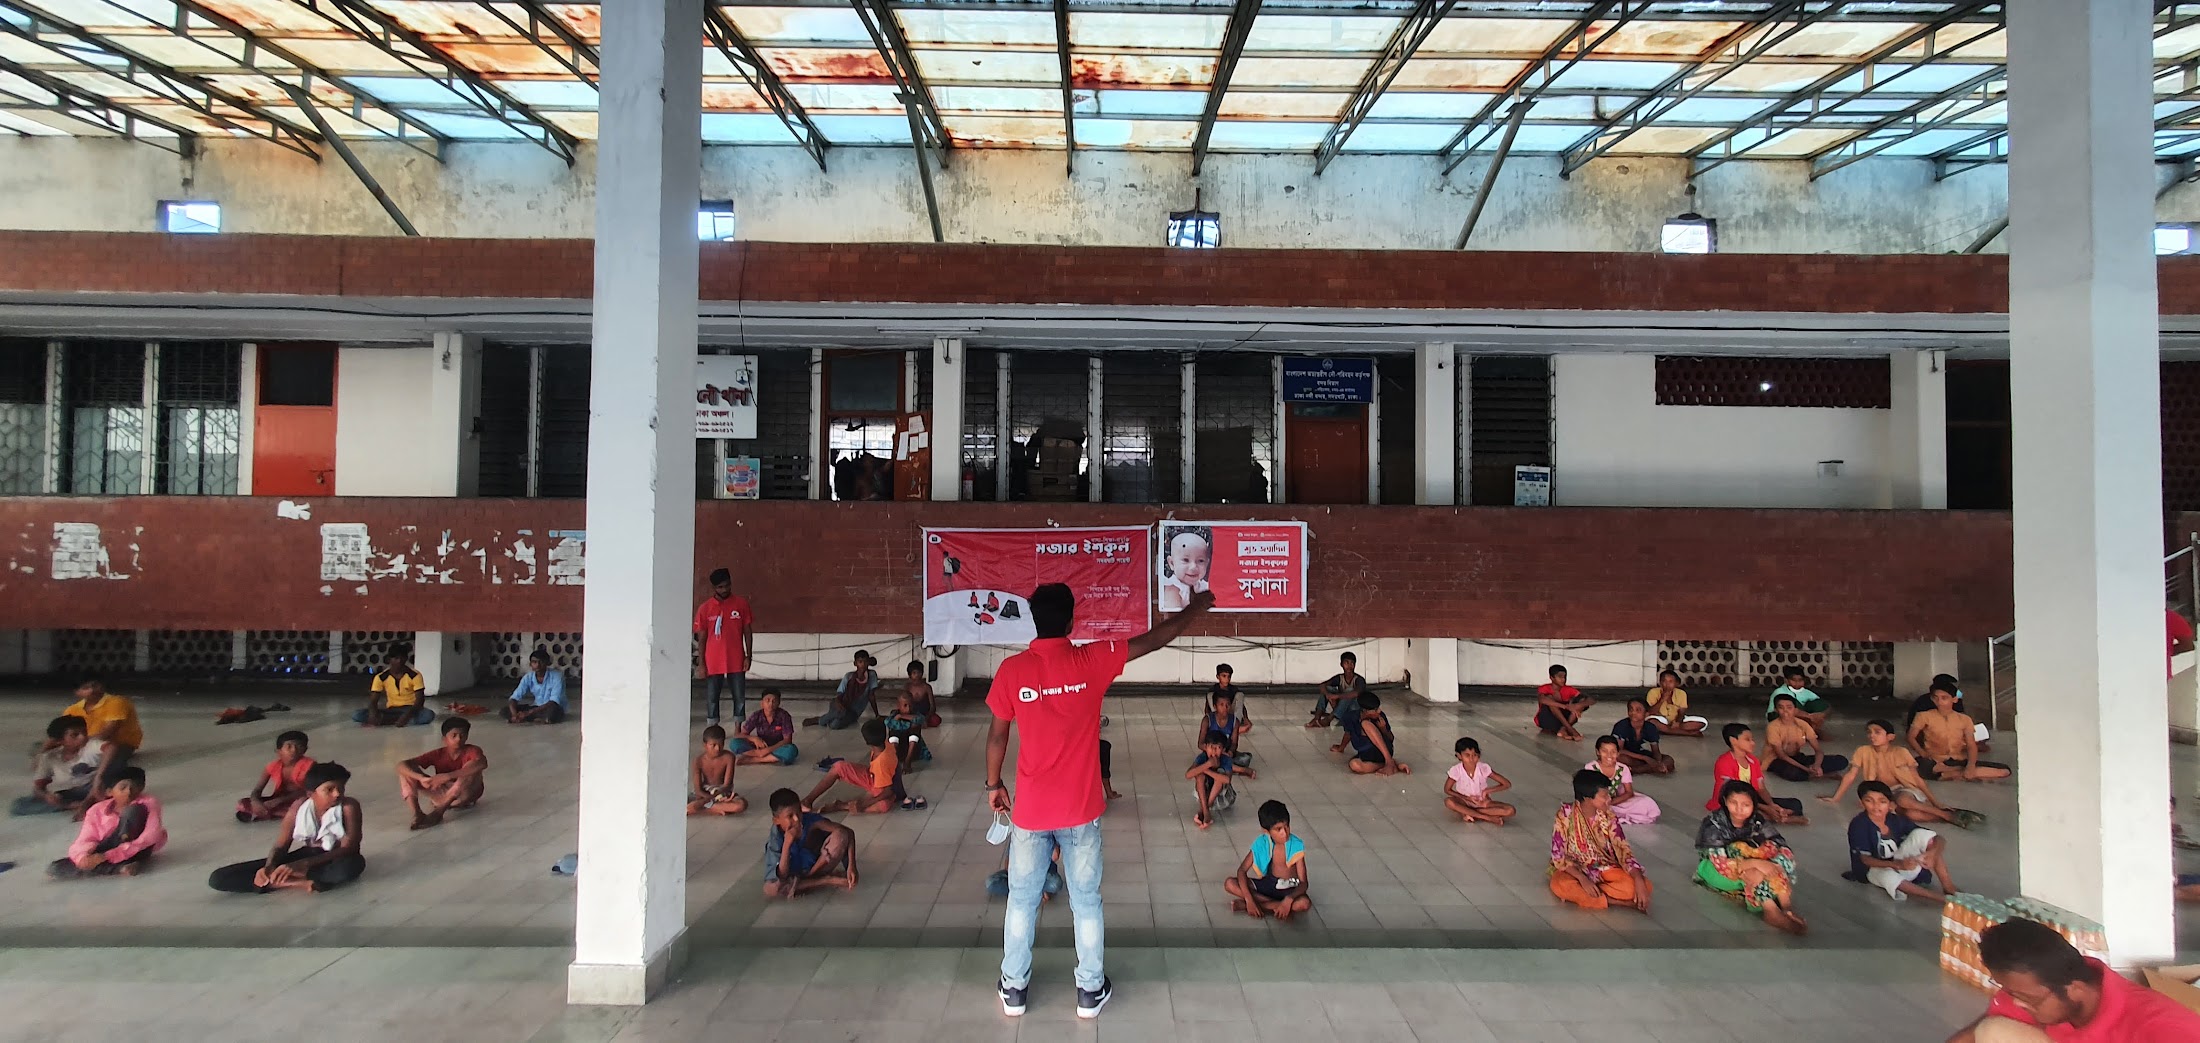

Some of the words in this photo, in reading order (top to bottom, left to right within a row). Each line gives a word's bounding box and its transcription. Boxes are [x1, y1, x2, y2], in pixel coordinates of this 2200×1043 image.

[1036, 543, 1078, 555] মজার
[1083, 538, 1131, 557] ইশকুল
[1237, 577, 1289, 600] সুশানা
[1042, 686, 1062, 696] মজার
[1063, 682, 1087, 694] ইশকুল
